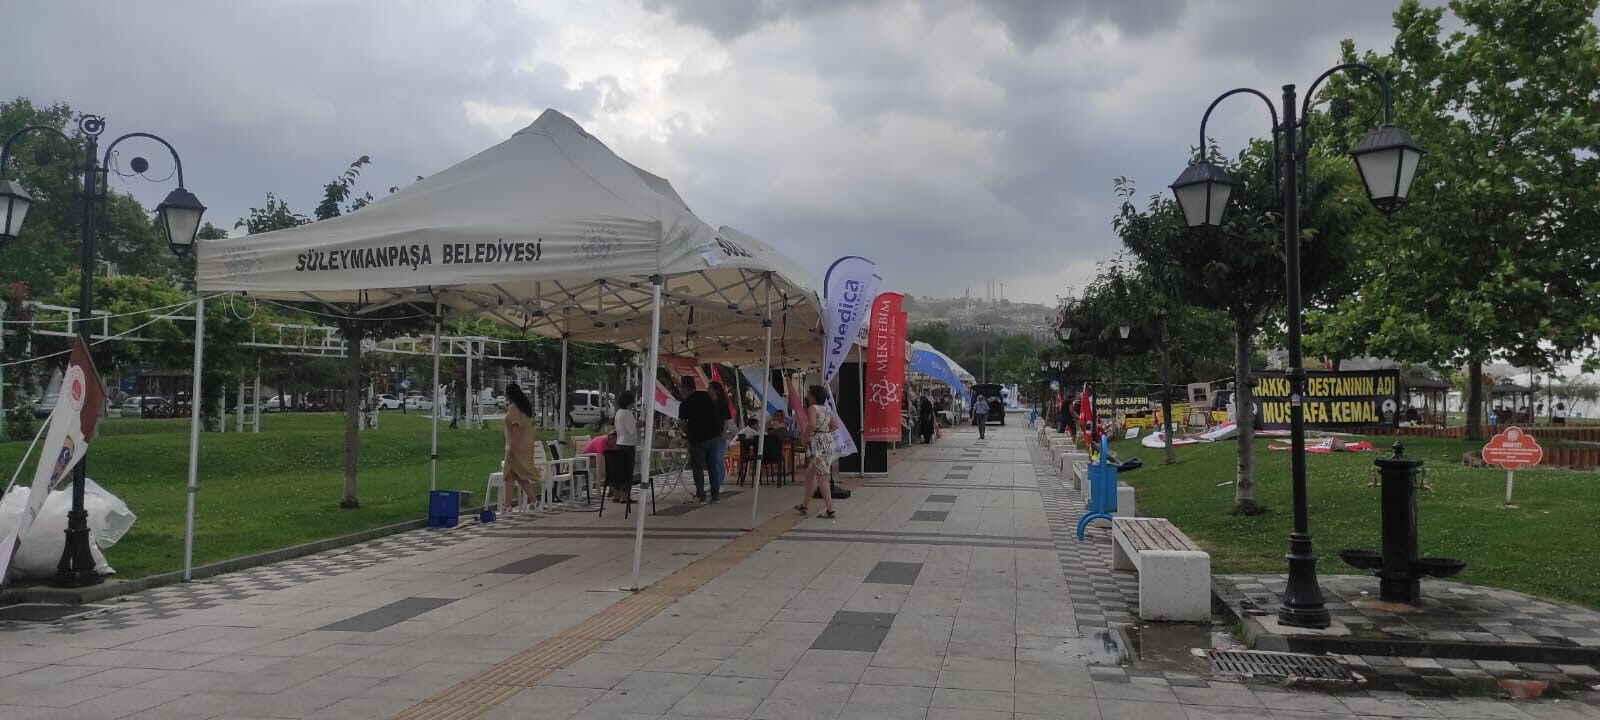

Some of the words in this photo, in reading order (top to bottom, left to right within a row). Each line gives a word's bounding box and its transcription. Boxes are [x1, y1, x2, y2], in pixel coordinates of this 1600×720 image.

[296, 244, 432, 271] SÜLEYMANPAŞA
[442, 238, 542, 264] BELEDİYESİ
[831, 279, 860, 355] Medica
[876, 300, 891, 373] MEKTEBİM
[1308, 376, 1374, 397] DESTANININ
[1377, 376, 1395, 396] ADI
[1262, 401, 1329, 424] MUSAFA
[1332, 401, 1379, 423] KEMAL
